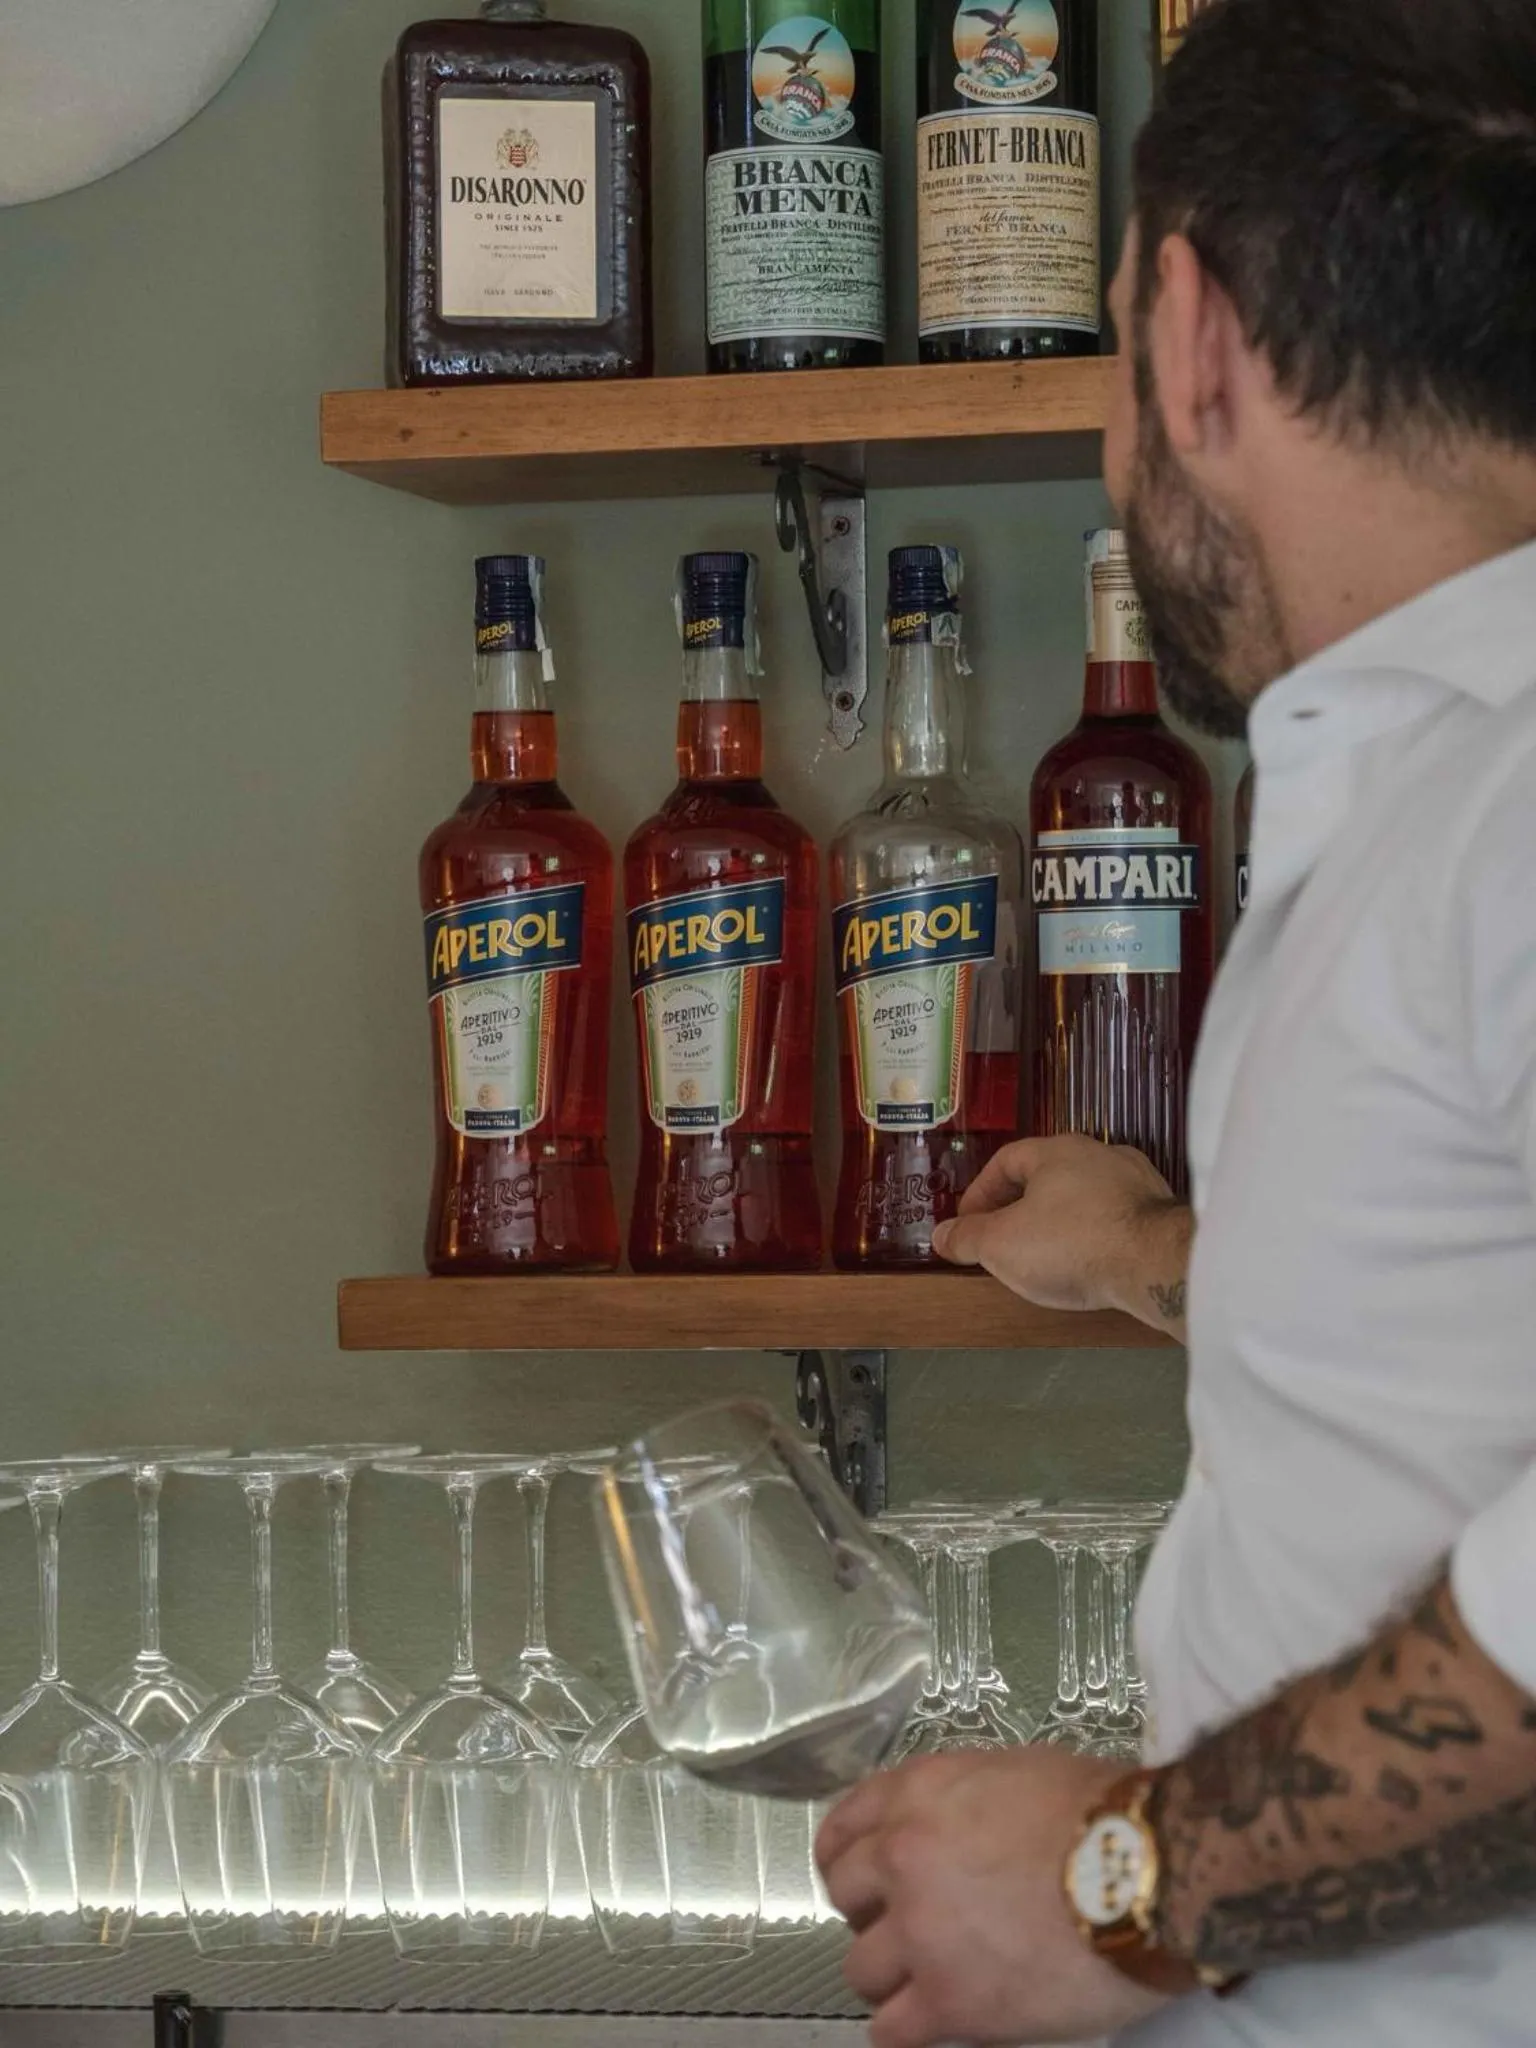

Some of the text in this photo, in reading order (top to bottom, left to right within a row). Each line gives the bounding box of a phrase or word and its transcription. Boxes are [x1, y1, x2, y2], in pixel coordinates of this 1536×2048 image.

[927, 127, 1086, 172] FERNET-BRANCA
[734, 159, 872, 190] BRANCA
[449, 176, 585, 207] DISARONNO
[734, 189, 872, 217] MENTA
[474, 213, 564, 222] ORIGINALE
[495, 224, 519, 232] SINCE
[771, 219, 820, 230] BRANCA
[946, 222, 1068, 237] FERNET BRANCA
[758, 264, 855, 275] BRANCAMENTA
[1031, 855, 1194, 903] CAMPARI
[432, 910, 567, 980] APEROL
[634, 905, 766, 976] APEROL
[842, 902, 980, 972] APEROL
[1064, 942, 1143, 954] MILANO
[460, 1006, 521, 1031] APERITIVO
[662, 1002, 720, 1025] APERITIVO
[873, 998, 935, 1025] APERITIVO
[477, 1031, 503, 1047] 1919
[676, 1027, 702, 1043] 1919
[890, 1024, 917, 1040] 1919
